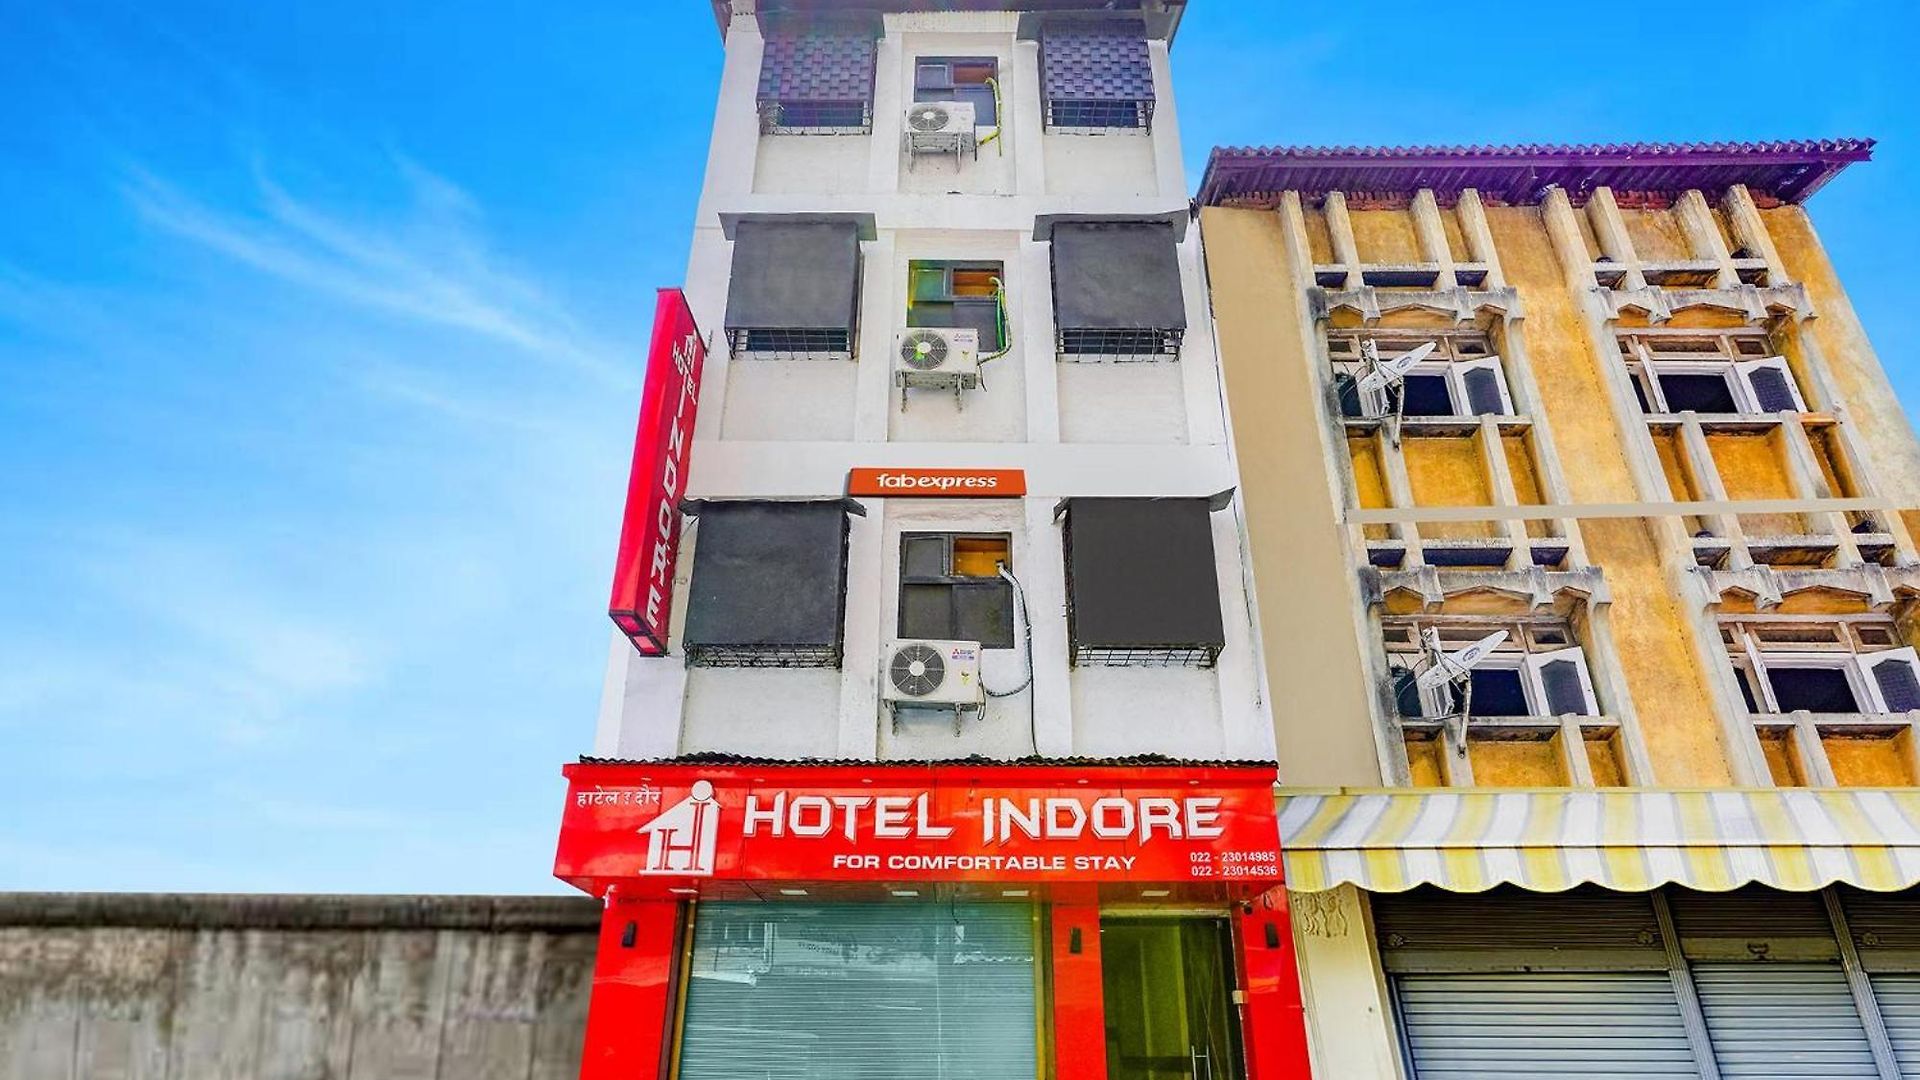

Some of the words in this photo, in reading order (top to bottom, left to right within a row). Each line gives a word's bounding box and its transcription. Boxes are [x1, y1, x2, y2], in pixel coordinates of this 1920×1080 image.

[672, 340, 697, 406] HOTEL
[646, 372, 687, 629] INDORE
[743, 791, 957, 846] HOTEL
[981, 795, 1226, 847] INDORE
[832, 854, 880, 869] FOR
[887, 855, 1066, 870] COMFORTABLE
[1074, 856, 1136, 870] STAY
[1190, 852, 1211, 862] 022
[1221, 851, 1277, 862] 23014985
[1191, 865, 1213, 876] 022
[1222, 865, 1278, 876] 23014536
